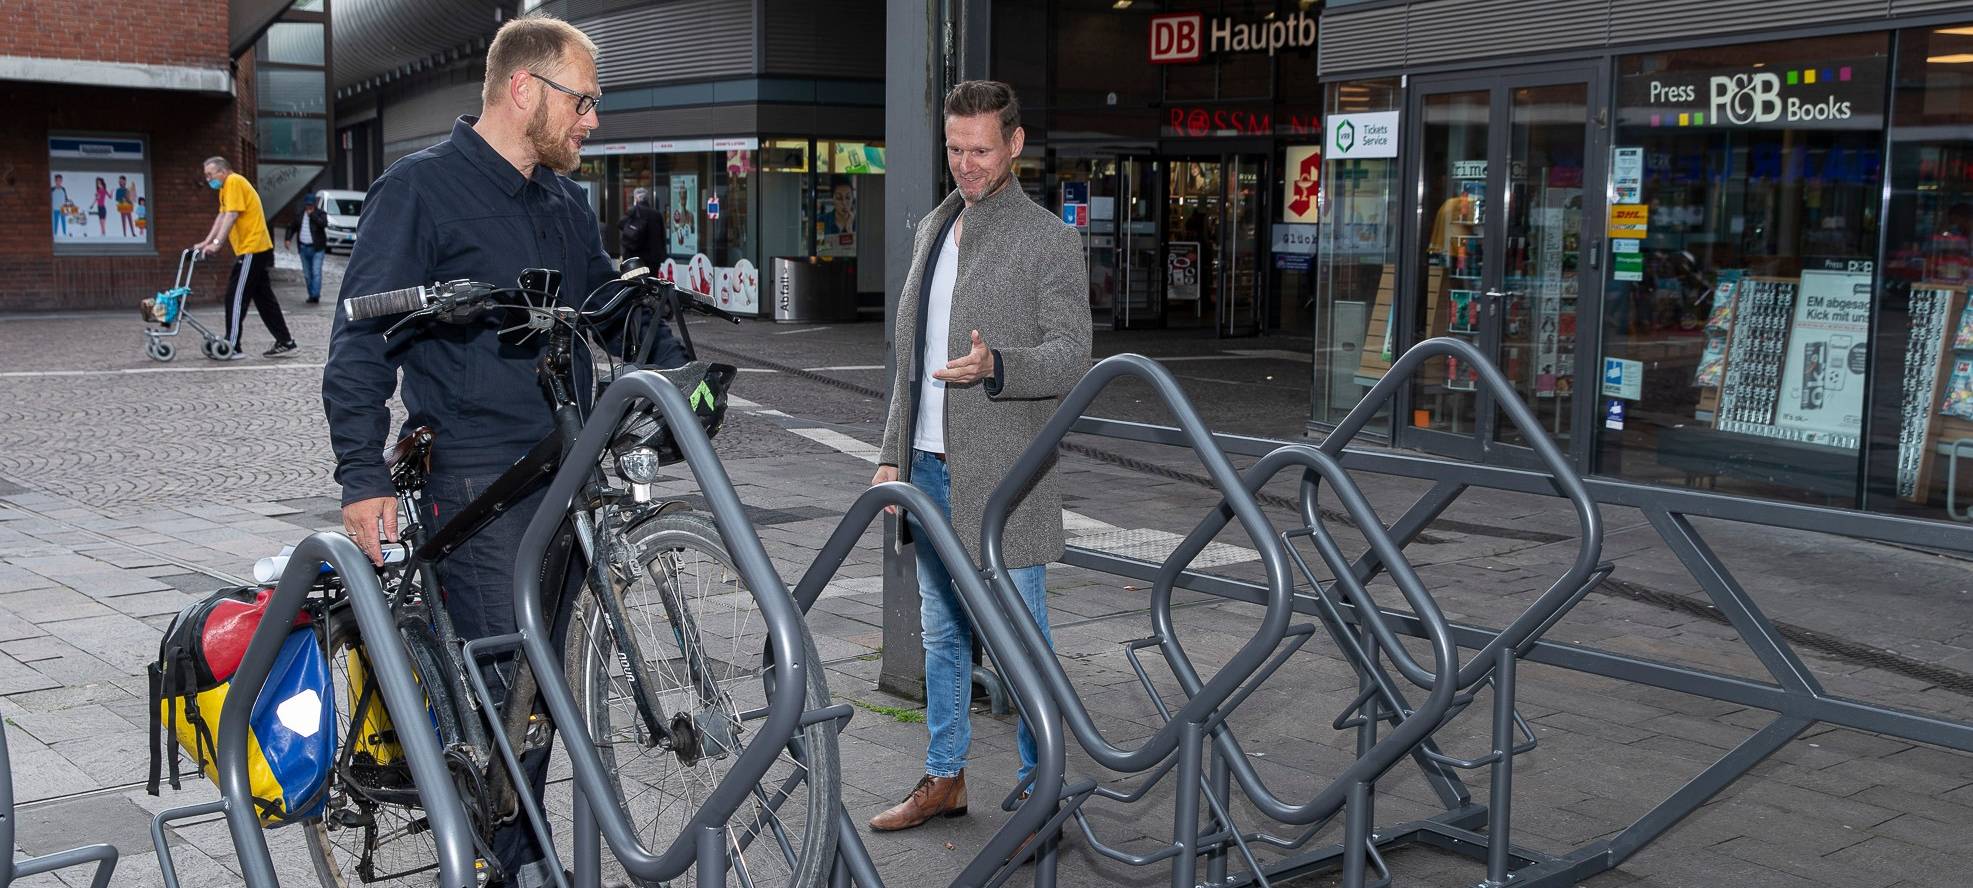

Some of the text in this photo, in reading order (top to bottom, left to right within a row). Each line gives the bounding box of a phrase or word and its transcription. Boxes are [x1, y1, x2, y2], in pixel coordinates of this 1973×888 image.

[1154, 21, 1196, 56] DB
[1210, 11, 1316, 56] Hauptb
[1650, 80, 1695, 103] Press
[1710, 72, 1782, 126] P&B
[1787, 95, 1851, 121] Books
[1363, 124, 1388, 135] Tickets
[1362, 135, 1388, 146] Service
[1616, 211, 1640, 219] DHL
[780, 276, 790, 312] Abfall
[1806, 296, 1824, 307] EM
[1806, 308, 1830, 321] Kick
[1832, 312, 1849, 322] mit
